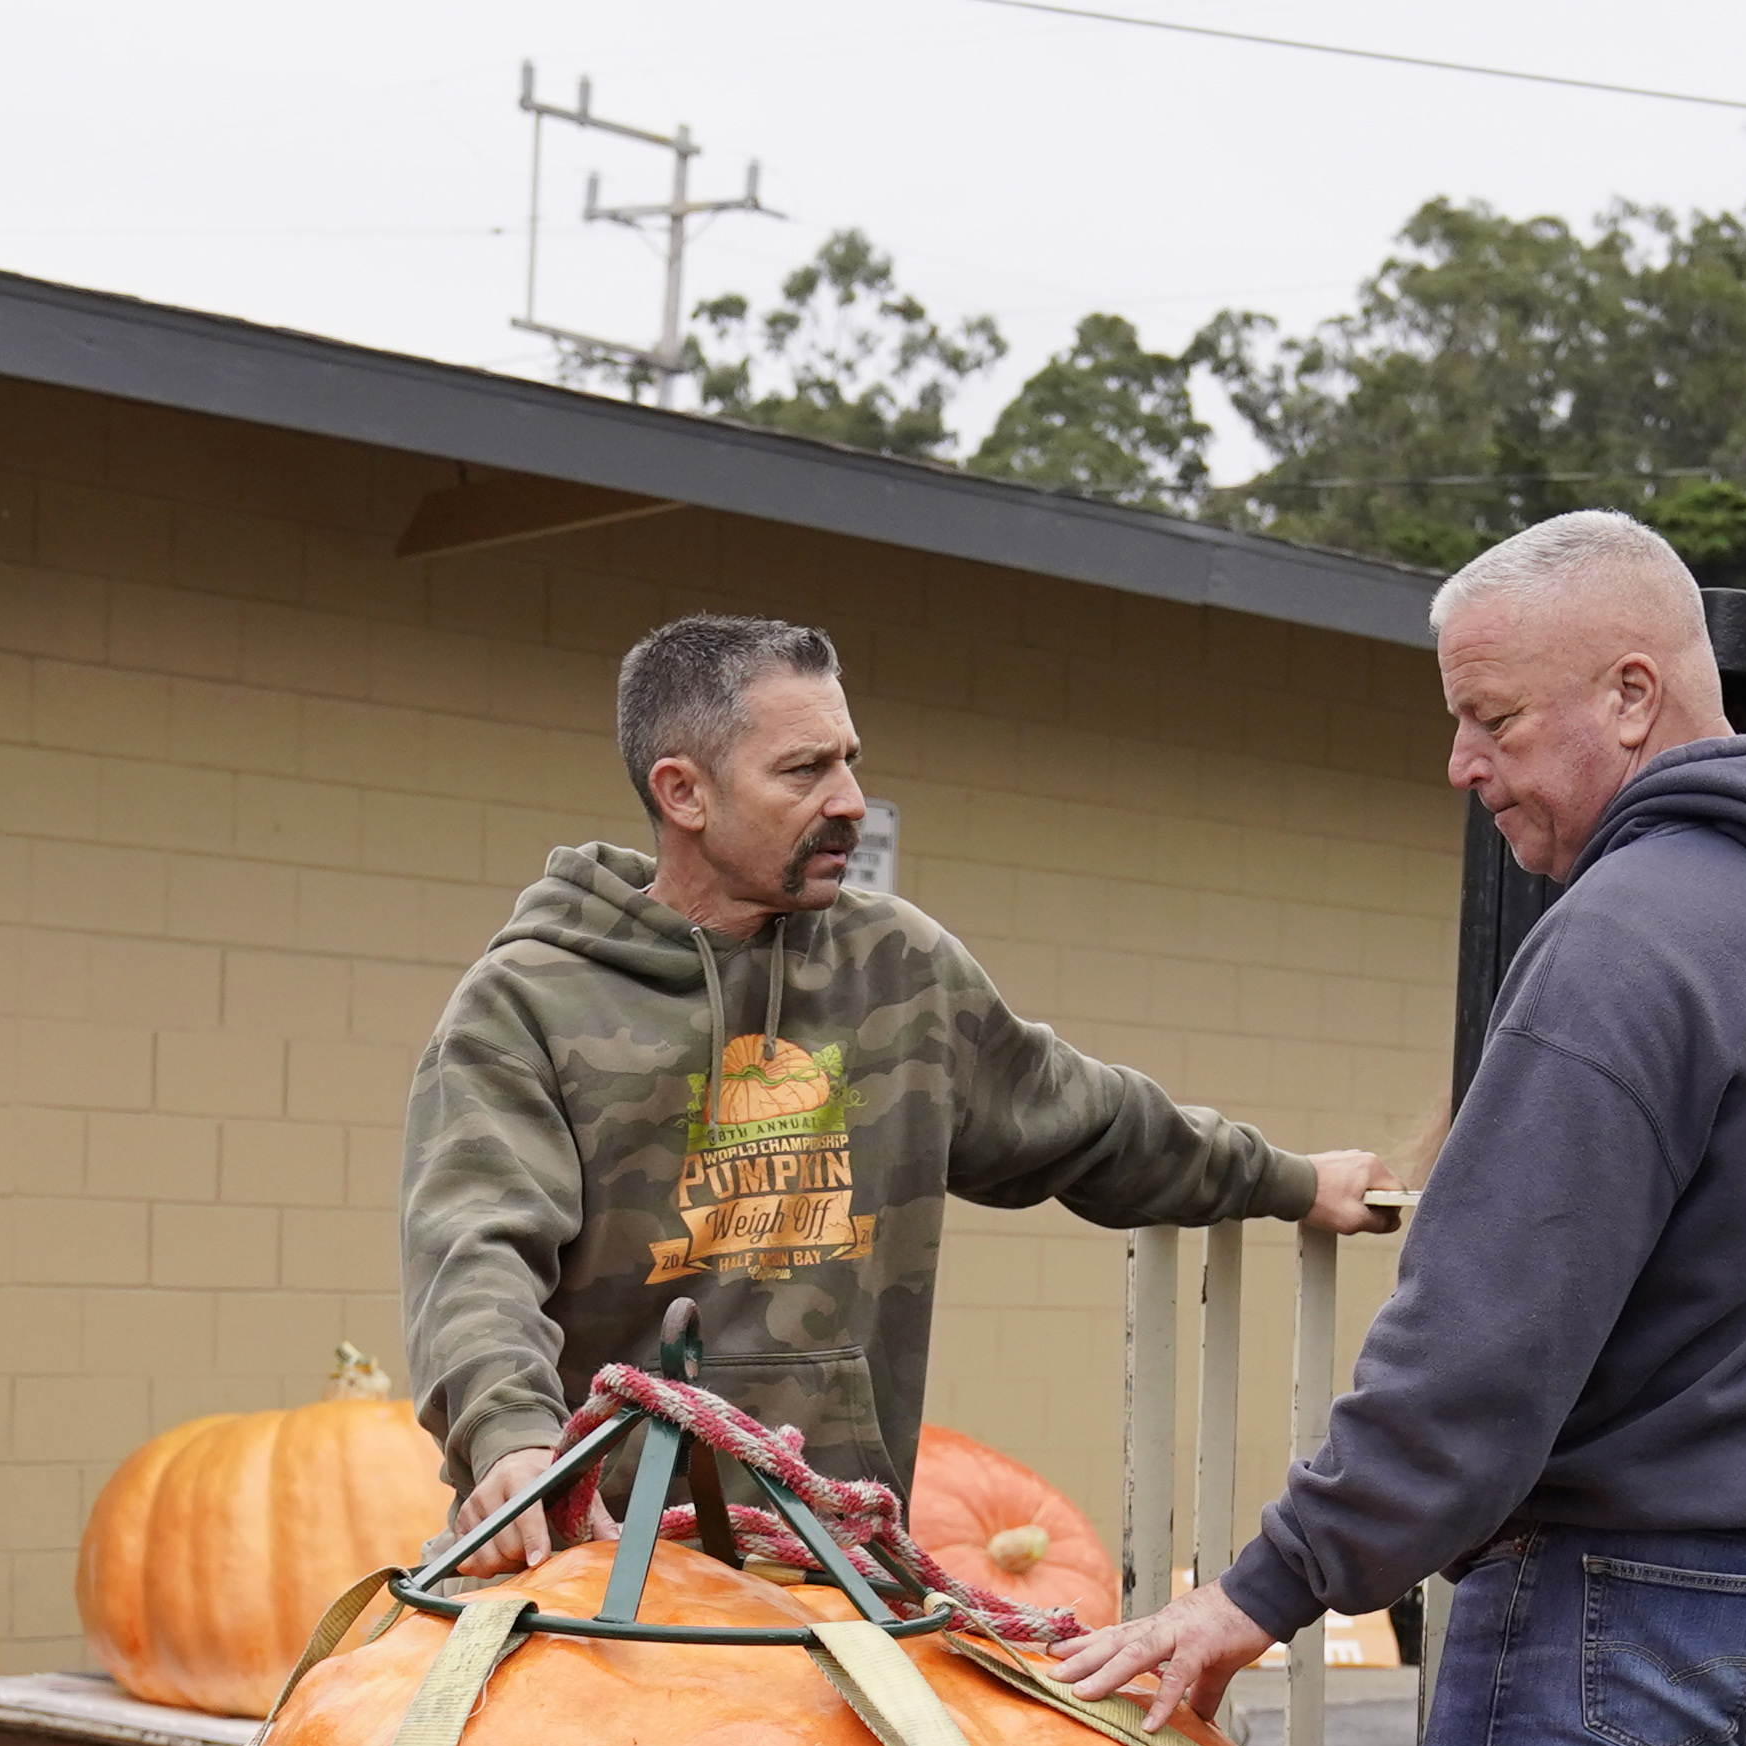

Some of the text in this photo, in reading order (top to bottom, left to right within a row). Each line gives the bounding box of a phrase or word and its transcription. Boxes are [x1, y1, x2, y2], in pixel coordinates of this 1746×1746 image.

[757, 1116, 819, 1134] ANNUAL
[703, 1133, 849, 1166] WORLD CHAMPISHIP
[678, 1150, 852, 1207] PUMPKIN
[705, 1196, 831, 1244] Weigh Off
[661, 1253, 679, 1270] 20
[719, 1252, 753, 1272] HALF
[793, 1250, 821, 1266] BAY
